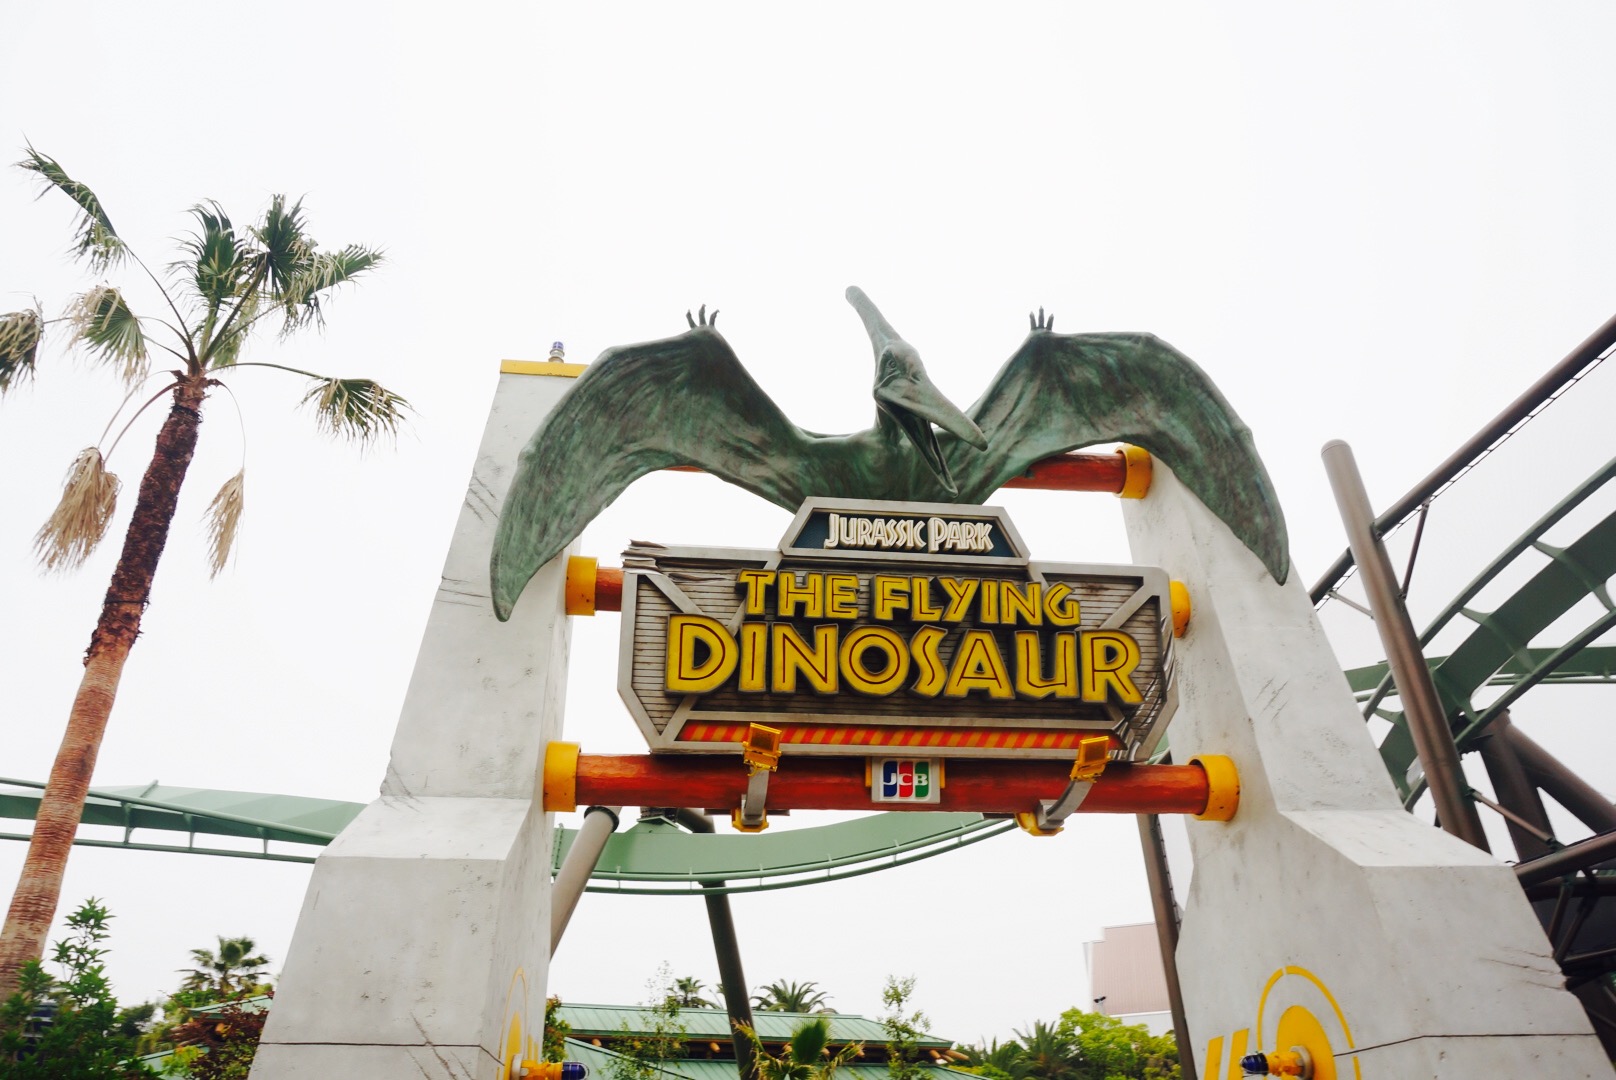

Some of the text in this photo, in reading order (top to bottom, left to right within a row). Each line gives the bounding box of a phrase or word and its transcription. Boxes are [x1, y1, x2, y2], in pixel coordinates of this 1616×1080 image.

[824, 513, 994, 553] JURASSIC PARK
[738, 570, 1081, 627] THE FLYING
[666, 614, 1145, 703] DINOSAUR
